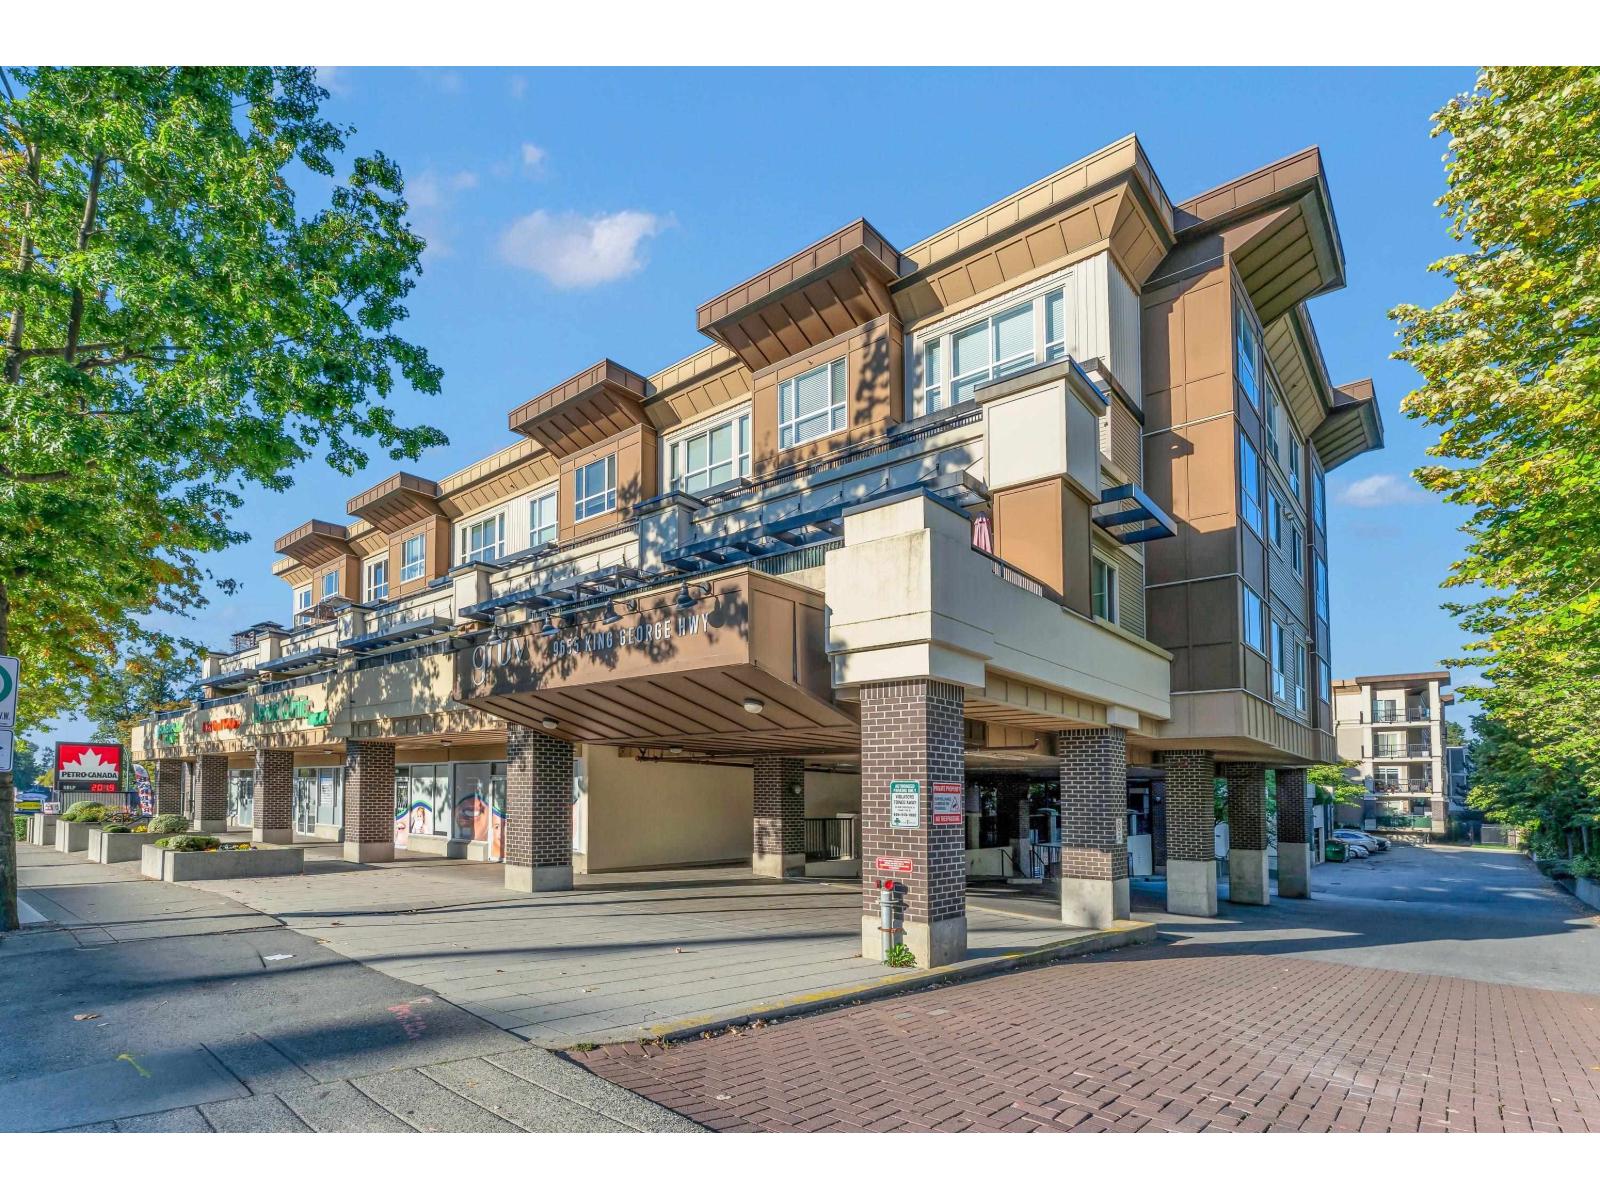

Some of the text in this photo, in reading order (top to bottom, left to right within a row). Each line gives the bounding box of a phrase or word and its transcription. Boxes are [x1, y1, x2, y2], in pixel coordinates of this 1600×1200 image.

[553, 612, 709, 657] 9655 KING GEORGE HWY
[61, 771, 118, 779] PETRO-CANADA
